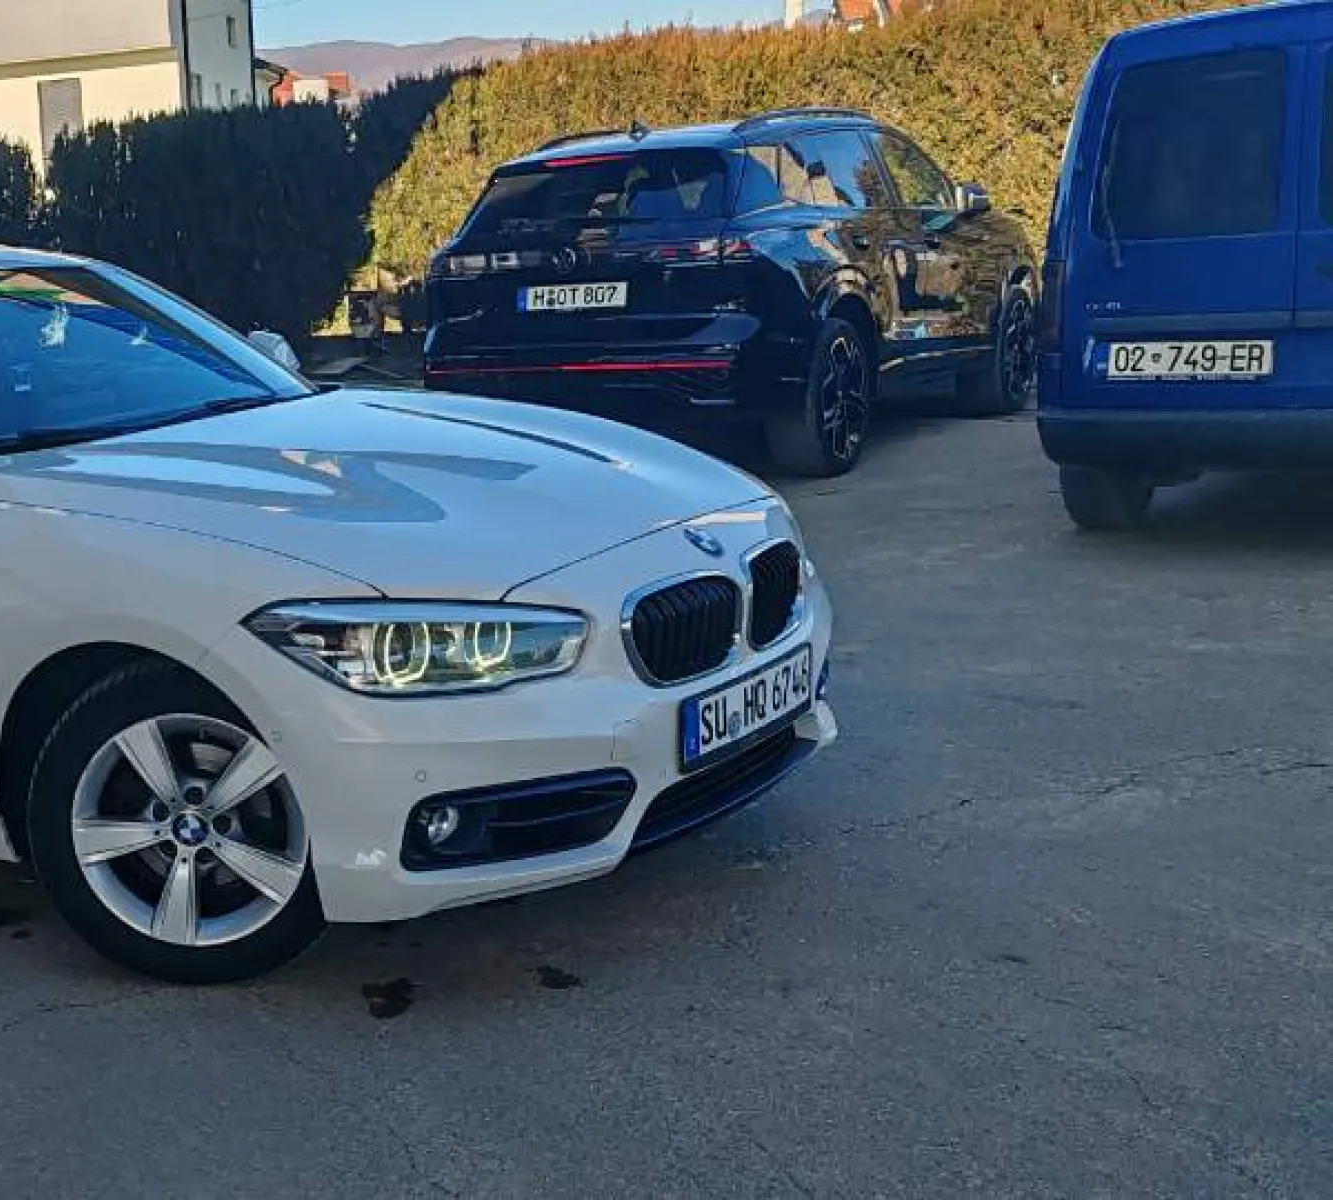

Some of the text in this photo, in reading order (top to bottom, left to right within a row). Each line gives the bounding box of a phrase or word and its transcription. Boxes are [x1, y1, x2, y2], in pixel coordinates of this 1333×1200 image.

[532, 288, 545, 307] H
[583, 285, 618, 304] 807
[1115, 346, 1145, 372] 02
[701, 697, 727, 745] SU
[743, 679, 767, 728] HQ
